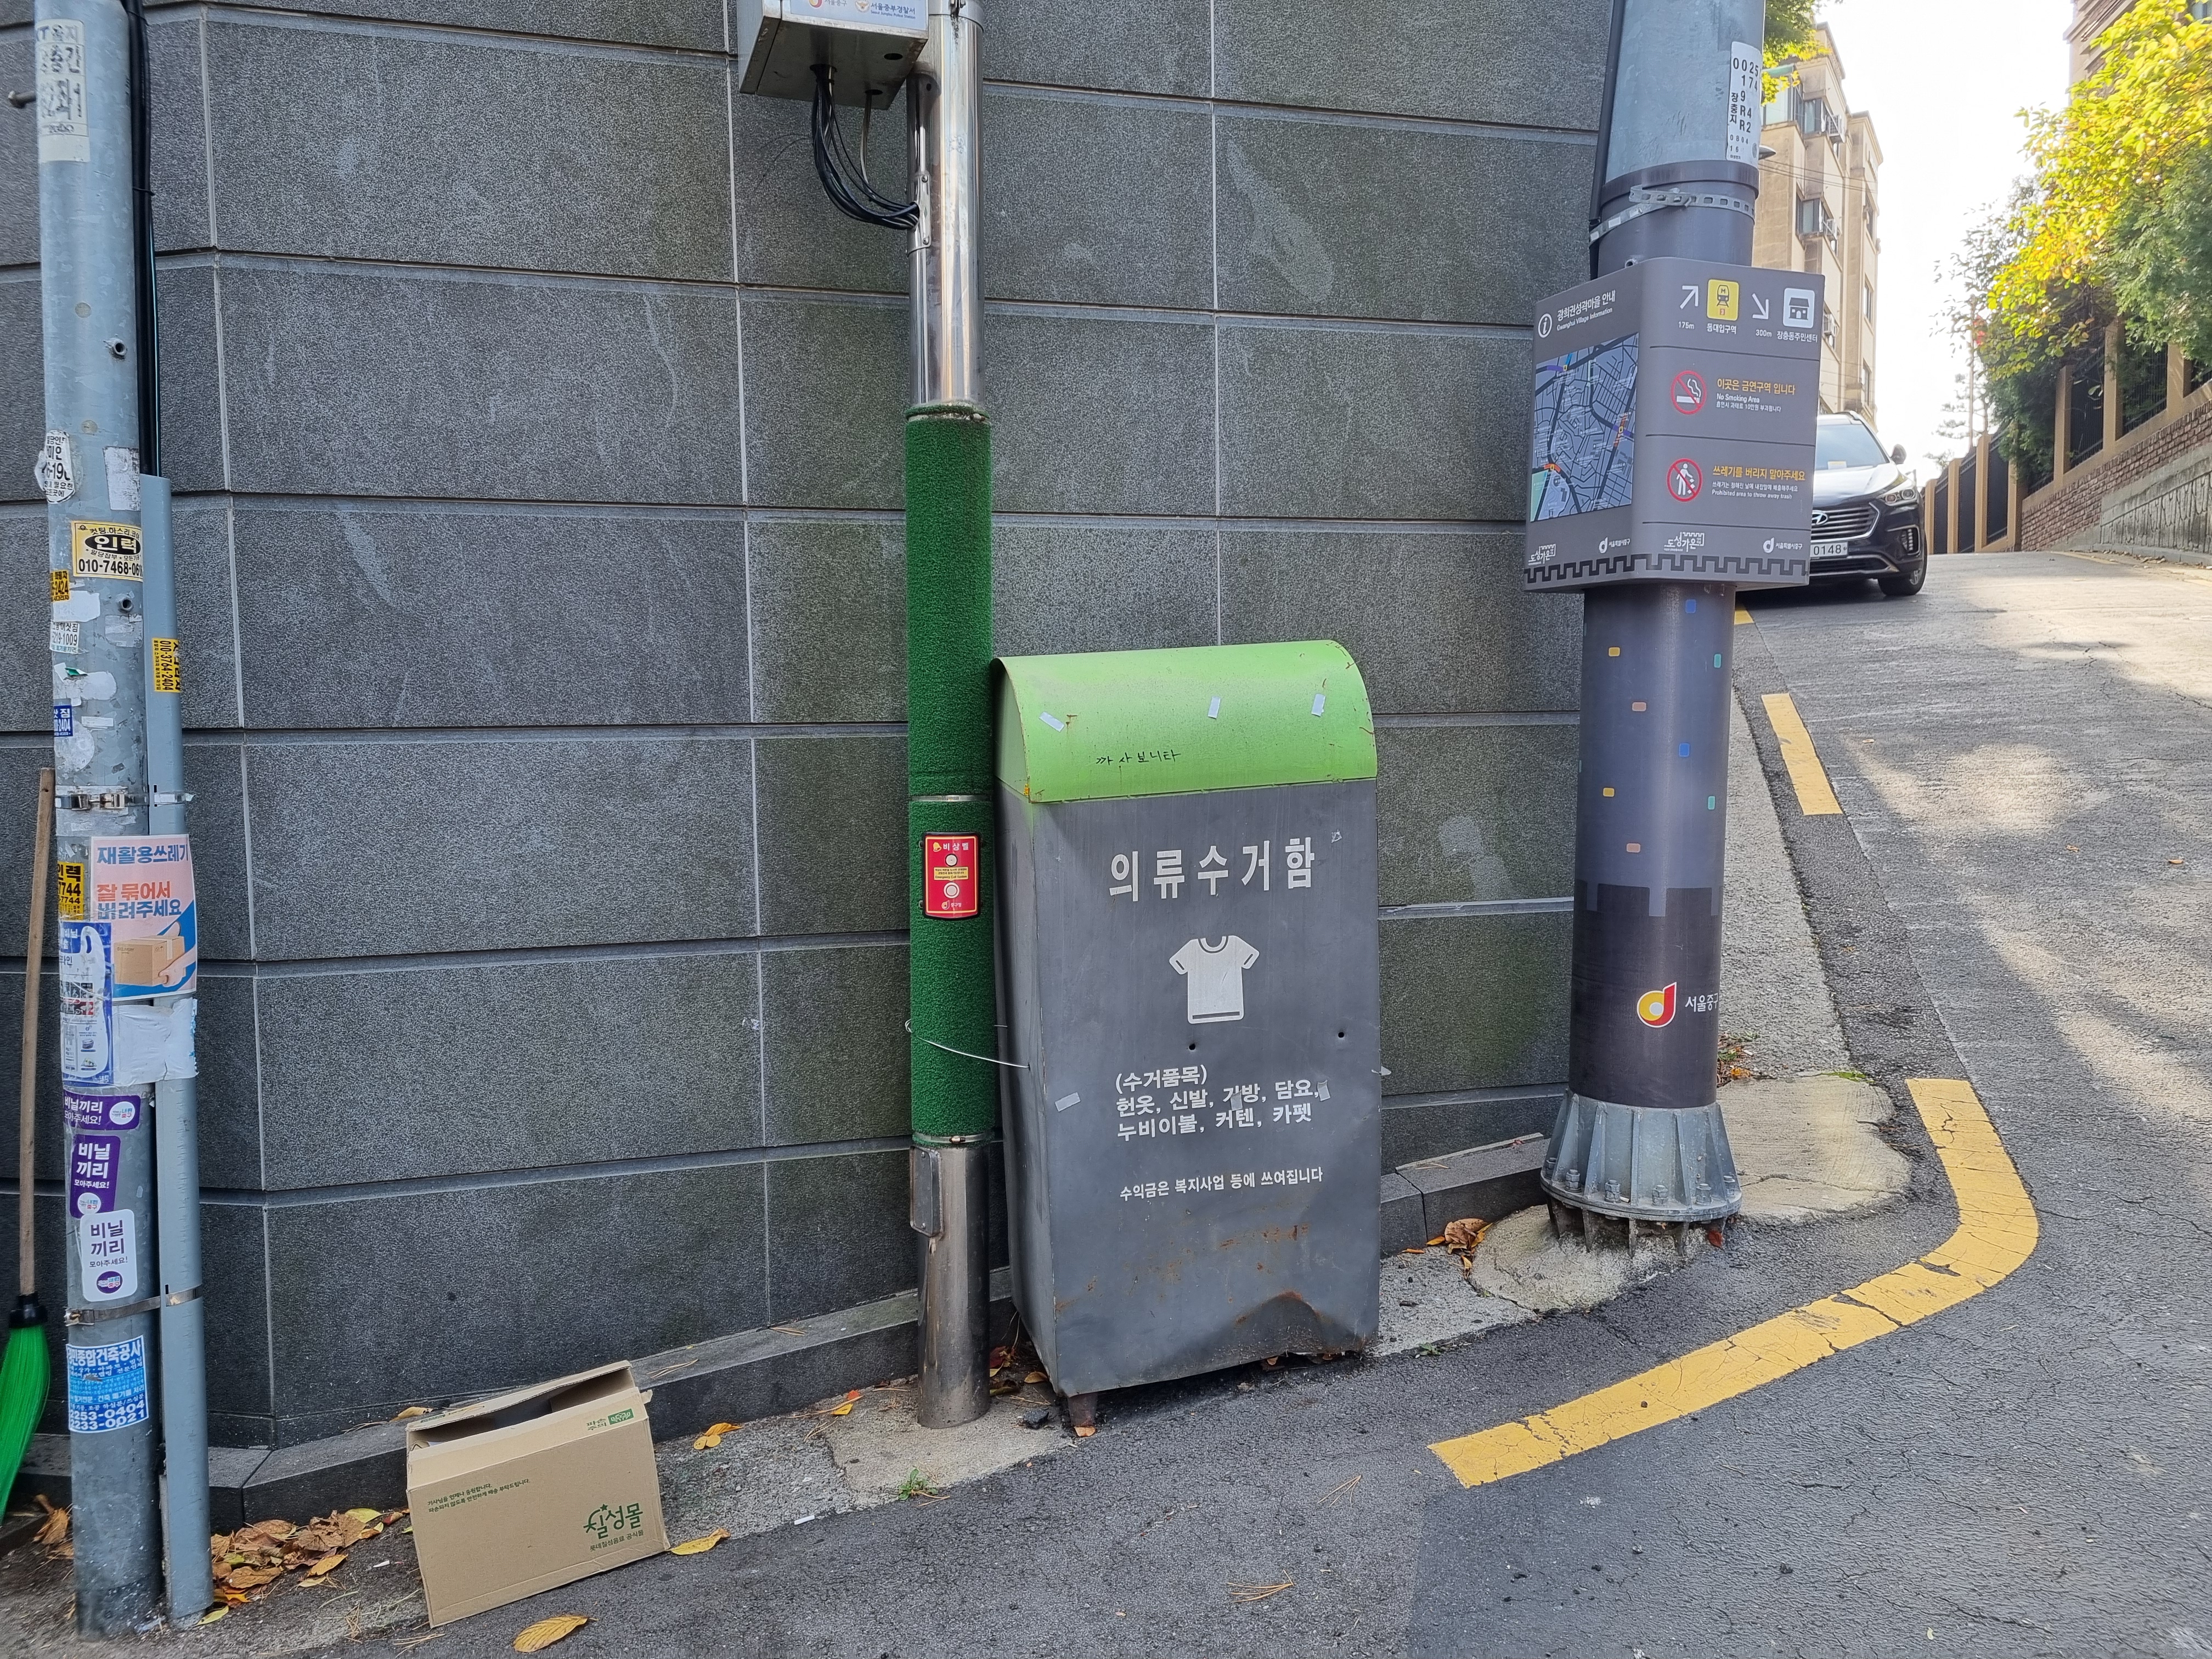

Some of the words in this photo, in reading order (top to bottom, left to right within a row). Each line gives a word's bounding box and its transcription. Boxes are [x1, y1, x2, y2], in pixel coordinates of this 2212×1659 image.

[871, 2, 915, 15] 서울중부경찰서
[1557, 295, 1601, 321] 광희권성곽마을
[1602, 290, 1616, 306] 안내
[1557, 319, 1576, 331] Gwanghui
[1576, 315, 1589, 324] Village
[1589, 307, 1613, 320] Information
[1678, 321, 1695, 330] 175m
[1707, 323, 1737, 335] 동대입구역
[1756, 330, 1772, 338] 300m
[1776, 331, 1818, 343] 장충동주민센터
[1717, 378, 1740, 391] 이곳은
[1742, 380, 1771, 394] 금연구역
[1774, 383, 1796, 396] 입니다
[1725, 393, 1747, 403] Smoking
[1760, 404, 1781, 413] 부과됩니다
[1712, 465, 1743, 478] 쓰레기를
[1745, 467, 1768, 479] 버리지
[1769, 469, 1805, 481] 말아주세요
[94, 535, 137, 554] 인력
[1813, 545, 1842, 555] 0148
[91, 549, 117, 560] 일당잡부
[97, 844, 189, 865] 재활용쓰레기
[943, 842, 969, 851] 비상벨
[1109, 837, 1315, 902] 의류수거함
[97, 884, 117, 902] 잘
[121, 881, 171, 901] 묶어서
[97, 899, 182, 921] 버려주세요
[1684, 992, 1719, 1013] 서울중구
[1115, 1064, 1207, 1094] (수거품목)
[64, 1096, 103, 1114] 비닐끼리
[1116, 1094, 1161, 1118] 헌옷,
[1170, 1088, 1214, 1111] 신발,
[64, 1110, 101, 1125] 모아주세요!
[1117, 1114, 1205, 1142] 누비이불,
[1215, 1108, 1262, 1130] 커텐,
[1273, 1102, 1312, 1125] 카펫
[78, 1142, 110, 1160] 비닐
[76, 1161, 109, 1179] 끼리
[74, 1179, 110, 1189] 모아주세요!
[1119, 1180, 1170, 1202] 수익금은
[1175, 1174, 1224, 1194] 복지사업
[1229, 1172, 1256, 1190] 등에
[1261, 1166, 1324, 1187] 쓰여집니다
[90, 1220, 124, 1239] 비닐
[91, 1238, 125, 1257] 끼리
[89, 1256, 128, 1268] 모아주세요!
[427, 1496, 448, 1506] 기사님을
[449, 1491, 465, 1500] 언제나
[465, 1483, 492, 1496] 응원합니다.
[428, 1503, 449, 1513] 파손되지
[450, 1498, 466, 1507] 않도록
[499, 1479, 531, 1492] 부탁드립니다.
[583, 1503, 643, 1539] 칠성몰
[590, 1536, 625, 1552] 롯데칠성음료
[626, 1529, 644, 1541] 공식몰
